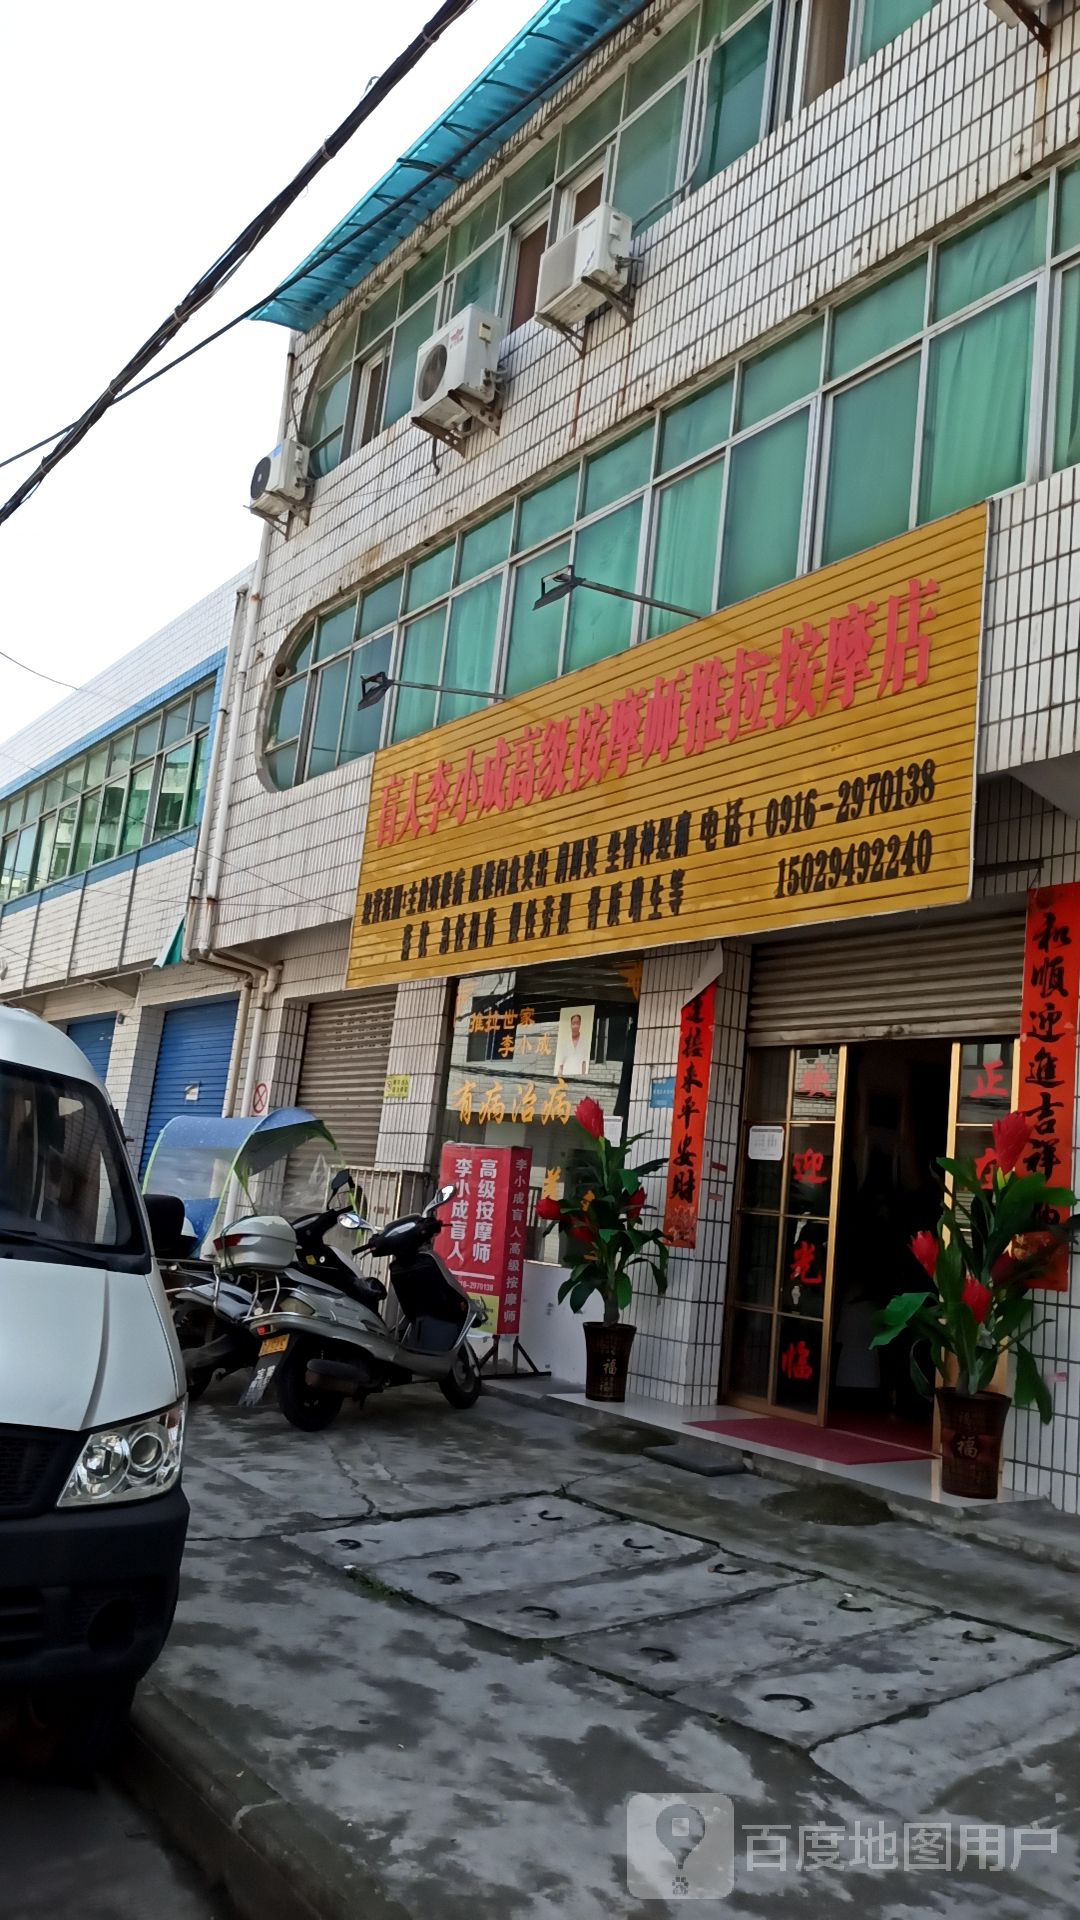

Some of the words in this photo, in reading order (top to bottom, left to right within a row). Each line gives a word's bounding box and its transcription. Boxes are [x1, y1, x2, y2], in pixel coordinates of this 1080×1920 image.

[376, 578, 940, 848] 盲人李小成高级按摩师推拉按摩店
[774, 829, 932, 898] 15029492240
[454, 1078, 572, 1126] 有病治病
[446, 1158, 473, 1267] 李小成盲人
[472, 1158, 498, 1264] 高级按摩师
[503, 1158, 528, 1324] 李小成盲人高级按摩师
